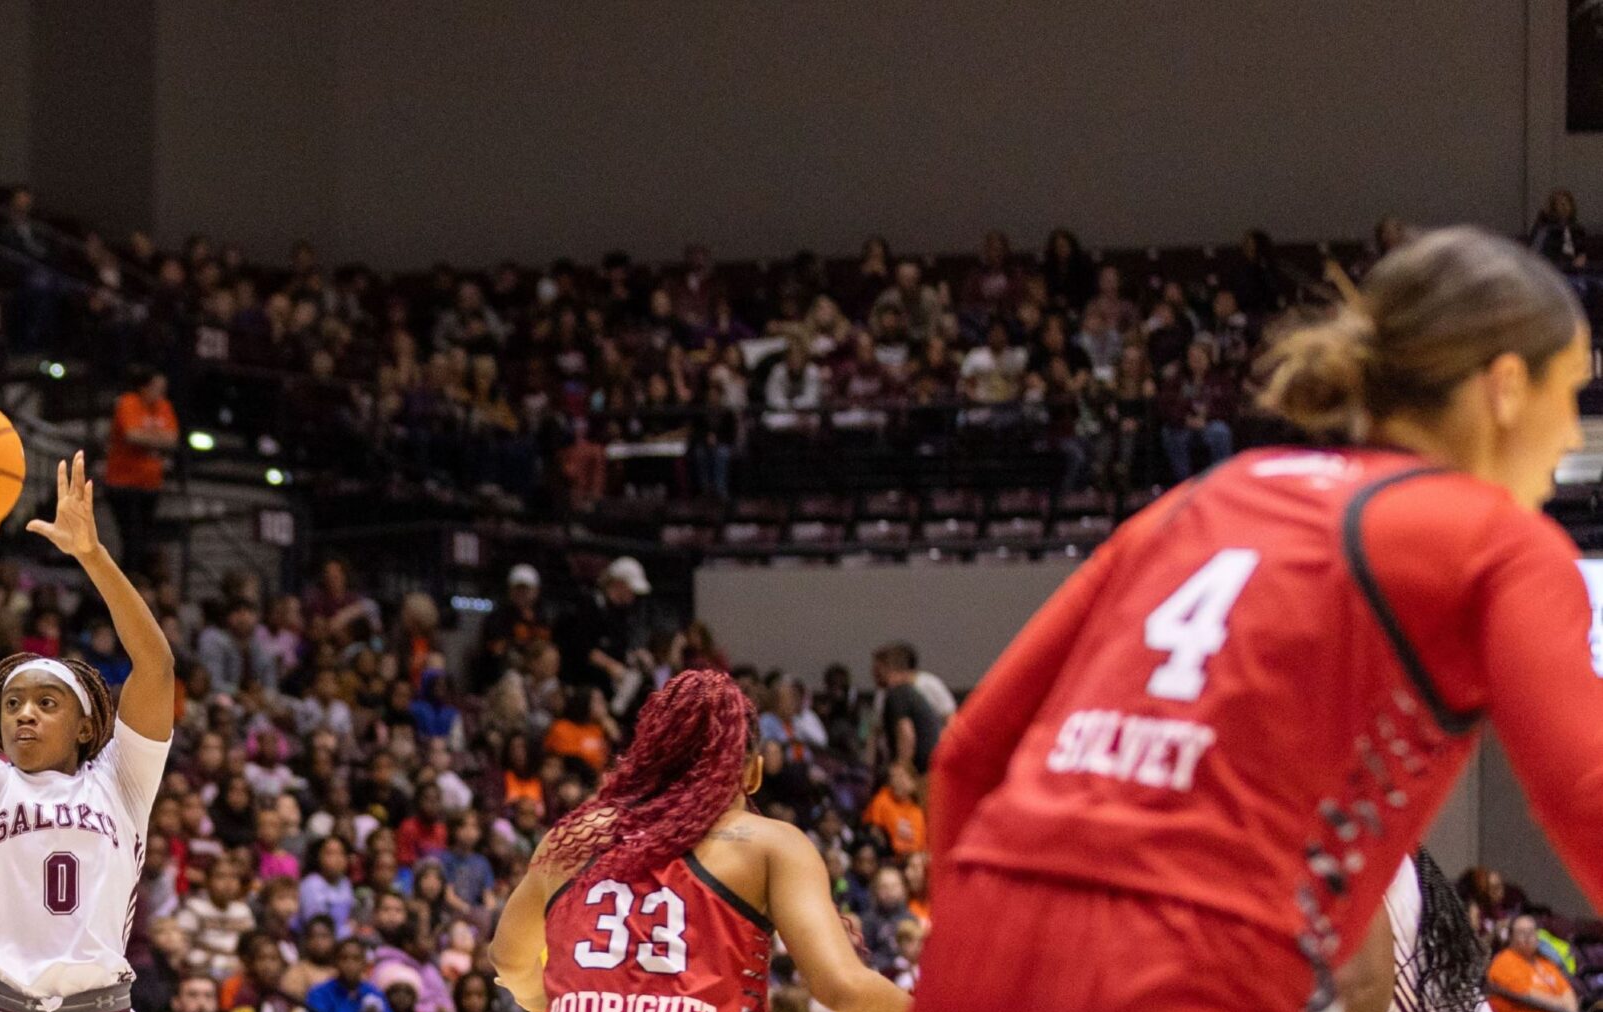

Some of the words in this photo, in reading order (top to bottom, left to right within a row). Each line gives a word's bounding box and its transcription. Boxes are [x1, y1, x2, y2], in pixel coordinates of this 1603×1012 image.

[1145, 548, 1259, 701] 4
[1047, 709, 1216, 791] SILVEY
[44, 851, 80, 915] 0
[574, 879, 688, 974] 33
